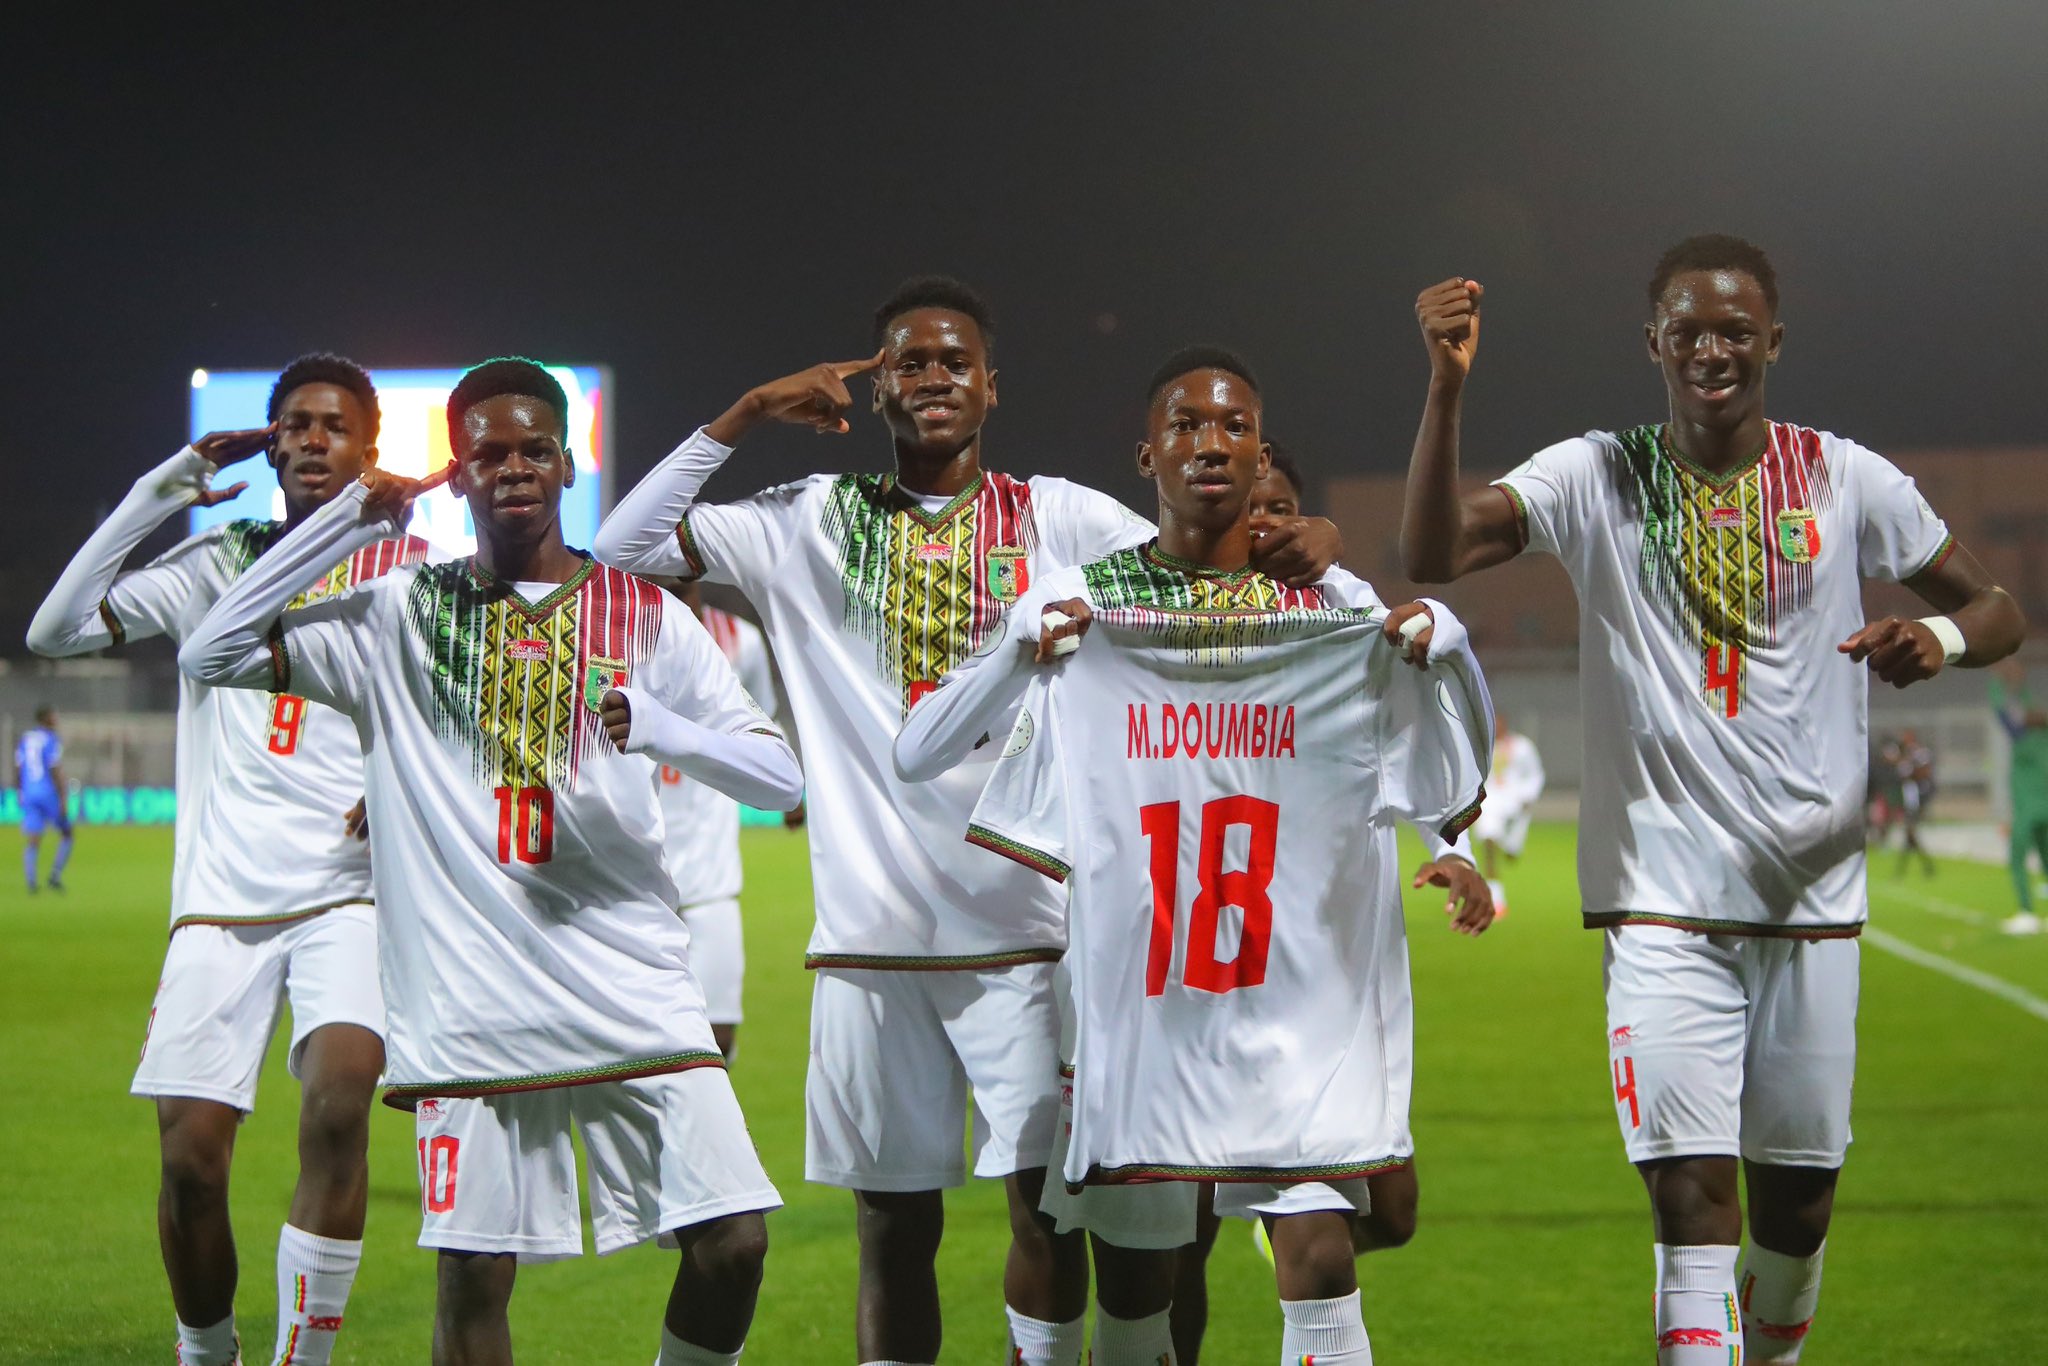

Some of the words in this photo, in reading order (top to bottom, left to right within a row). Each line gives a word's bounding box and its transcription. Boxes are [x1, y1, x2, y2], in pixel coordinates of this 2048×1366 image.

[1706, 645, 1740, 719] 4
[268, 694, 305, 756] 9
[1127, 702, 1296, 760] M.DOUMBIA
[494, 786, 554, 864] 10
[1139, 794, 1280, 997] 18
[1614, 1056, 1641, 1129] 4
[418, 1135, 460, 1216] 10
